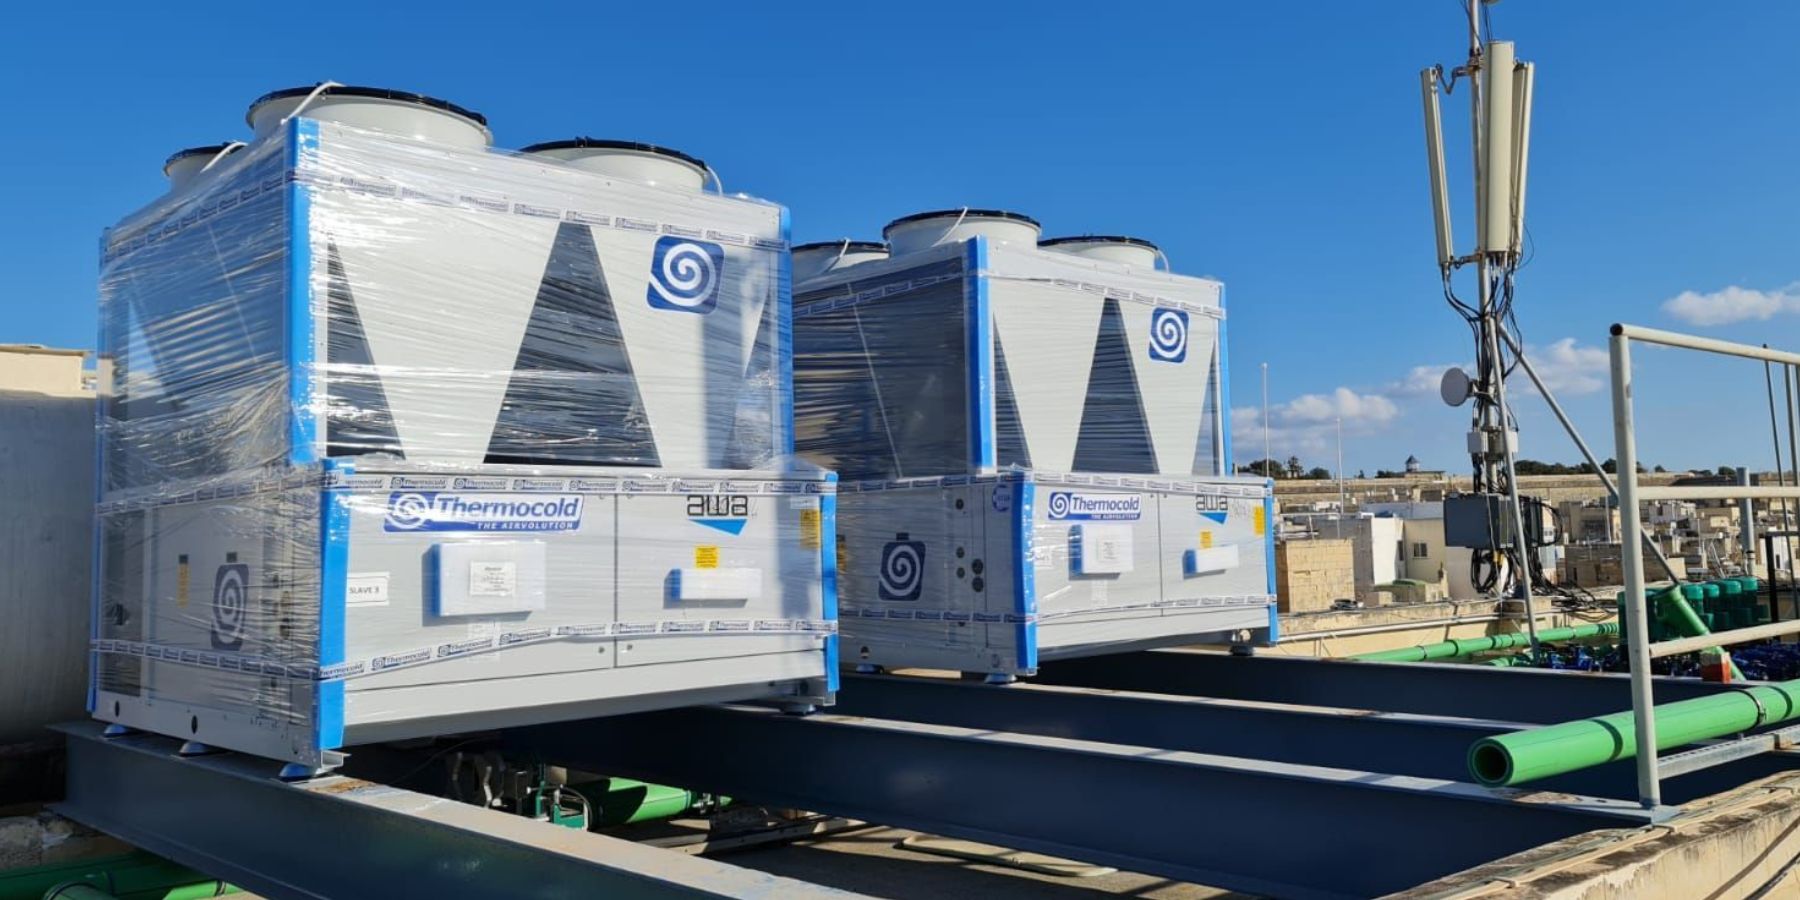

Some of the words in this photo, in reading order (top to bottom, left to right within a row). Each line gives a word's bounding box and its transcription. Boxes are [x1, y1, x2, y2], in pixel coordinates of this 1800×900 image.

[438, 497, 578, 518] Thermocold
[1073, 497, 1140, 511] Thermocold
[477, 522, 497, 530] THE
[502, 522, 573, 530] AIRVOLUTION
